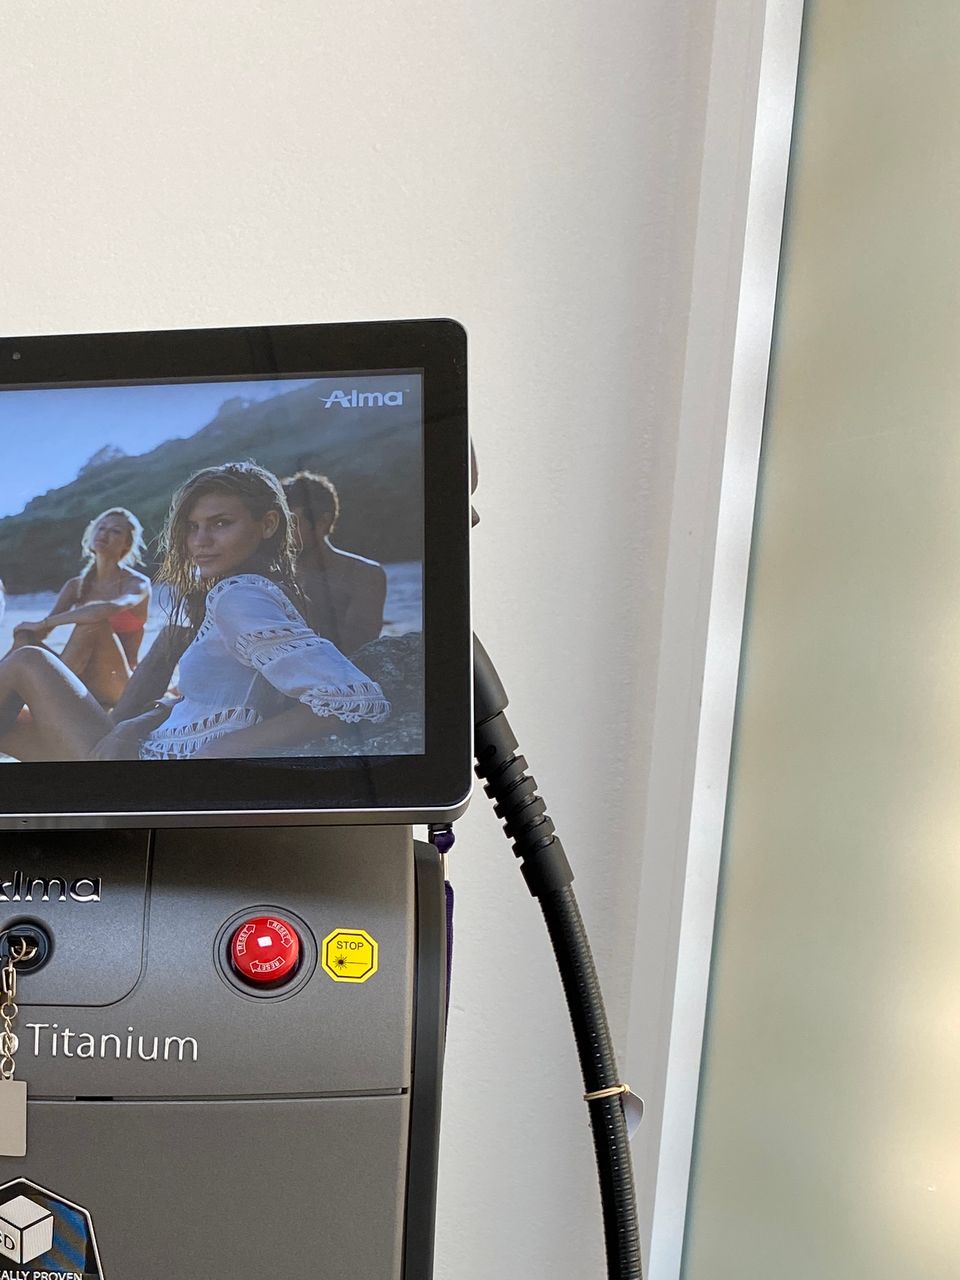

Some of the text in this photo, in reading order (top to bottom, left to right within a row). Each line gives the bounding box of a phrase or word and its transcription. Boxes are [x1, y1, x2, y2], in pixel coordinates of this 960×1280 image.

[320, 390, 403, 408] Alma
[336, 940, 364, 951] STOP
[25, 1023, 199, 1061] Titanium
